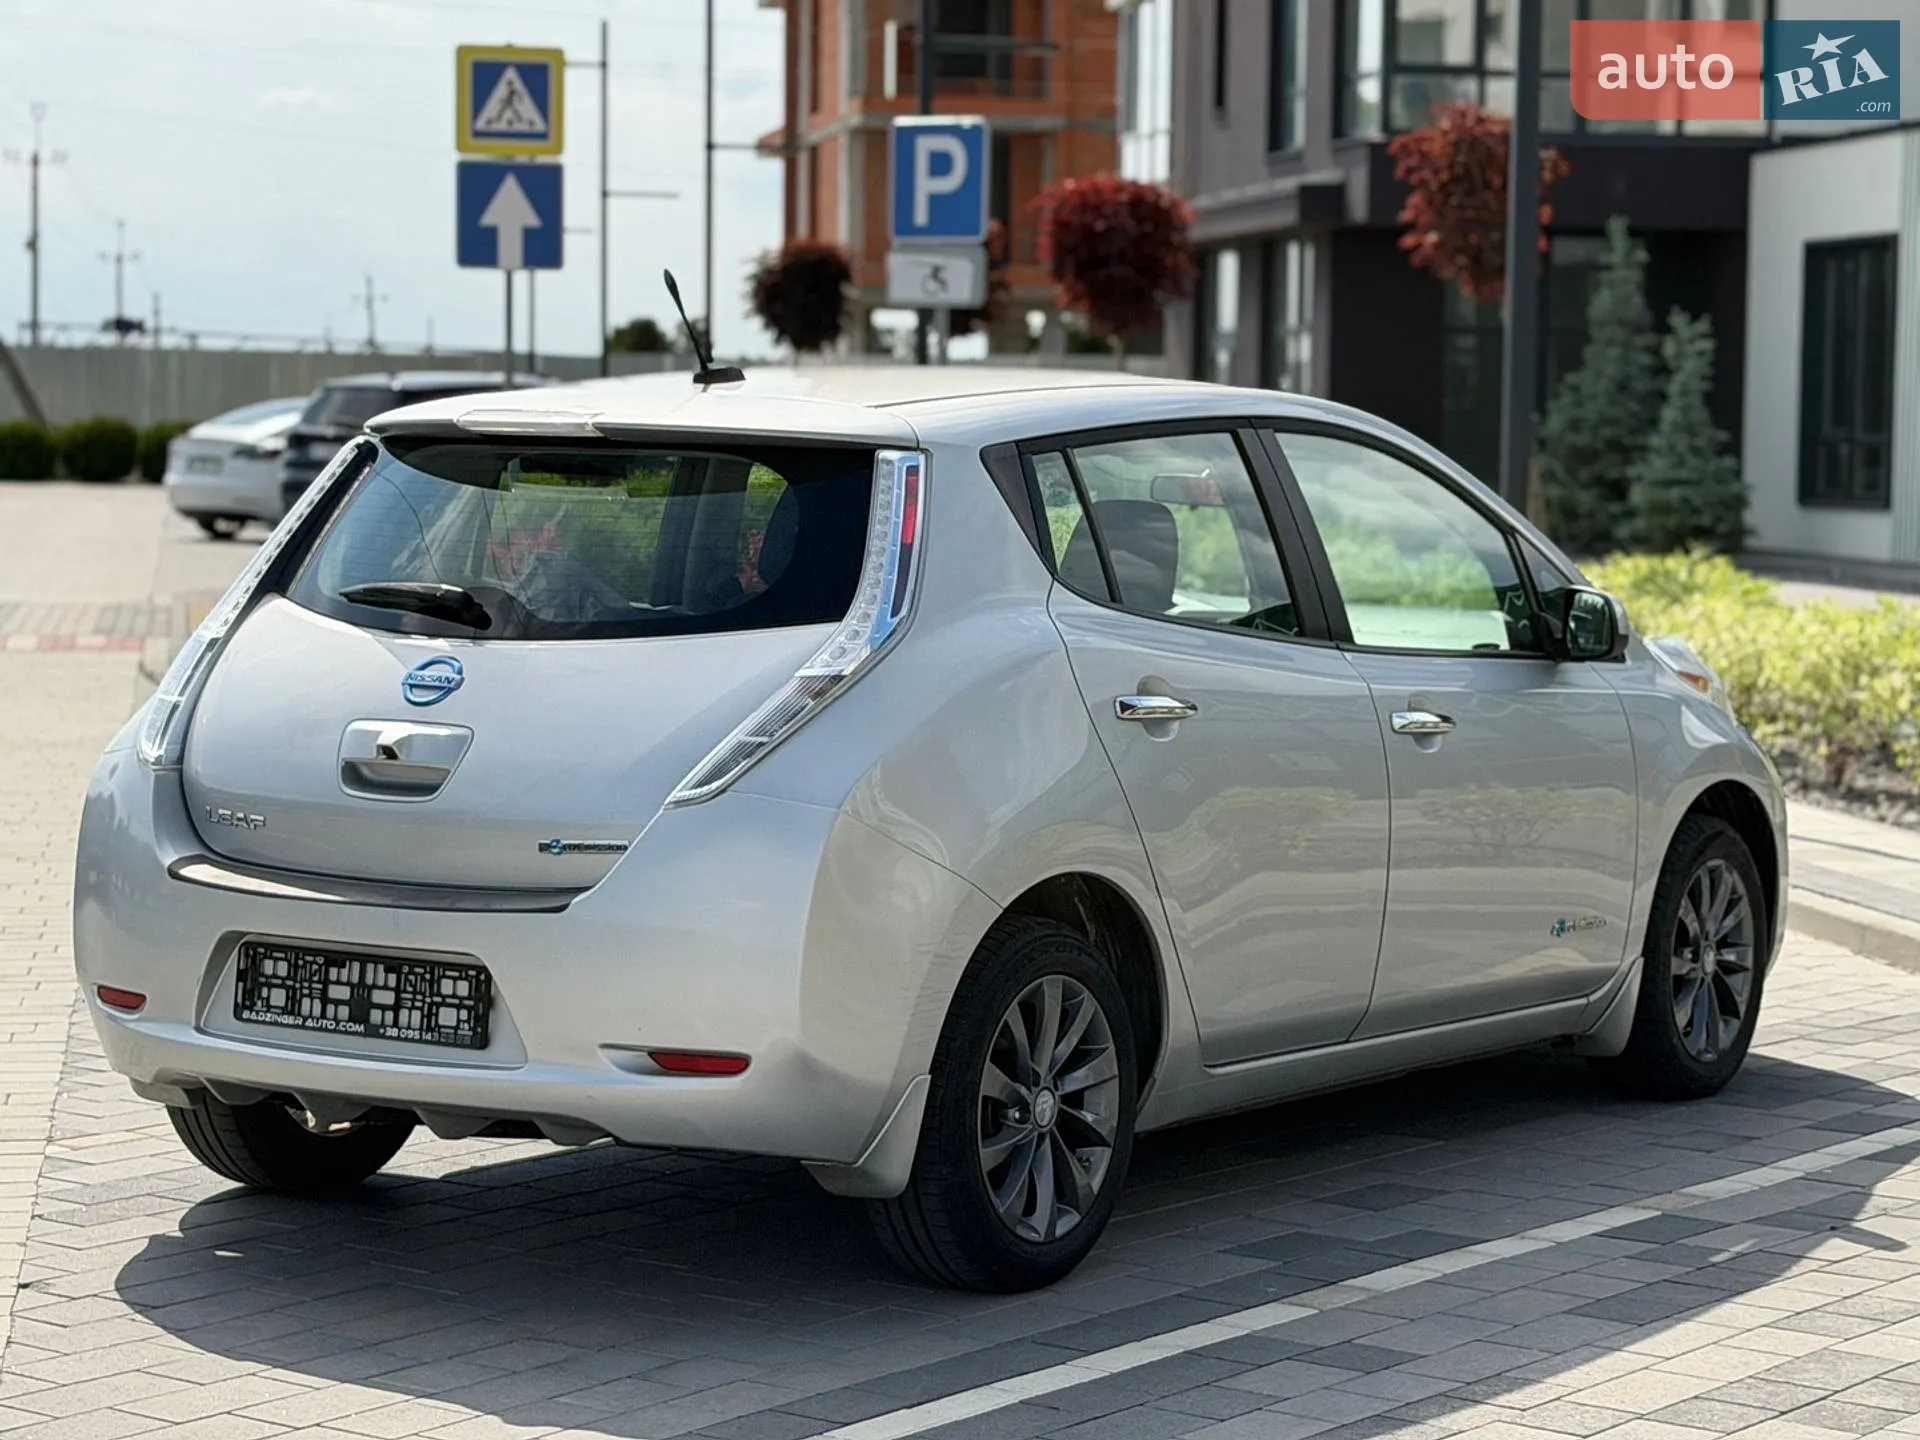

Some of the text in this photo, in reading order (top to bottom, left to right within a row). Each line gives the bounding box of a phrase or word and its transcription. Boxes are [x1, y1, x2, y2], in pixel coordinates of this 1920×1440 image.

[912, 133, 968, 229] P
[407, 672, 456, 685] NISSAN
[242, 1009, 303, 1026] BADZINGER
